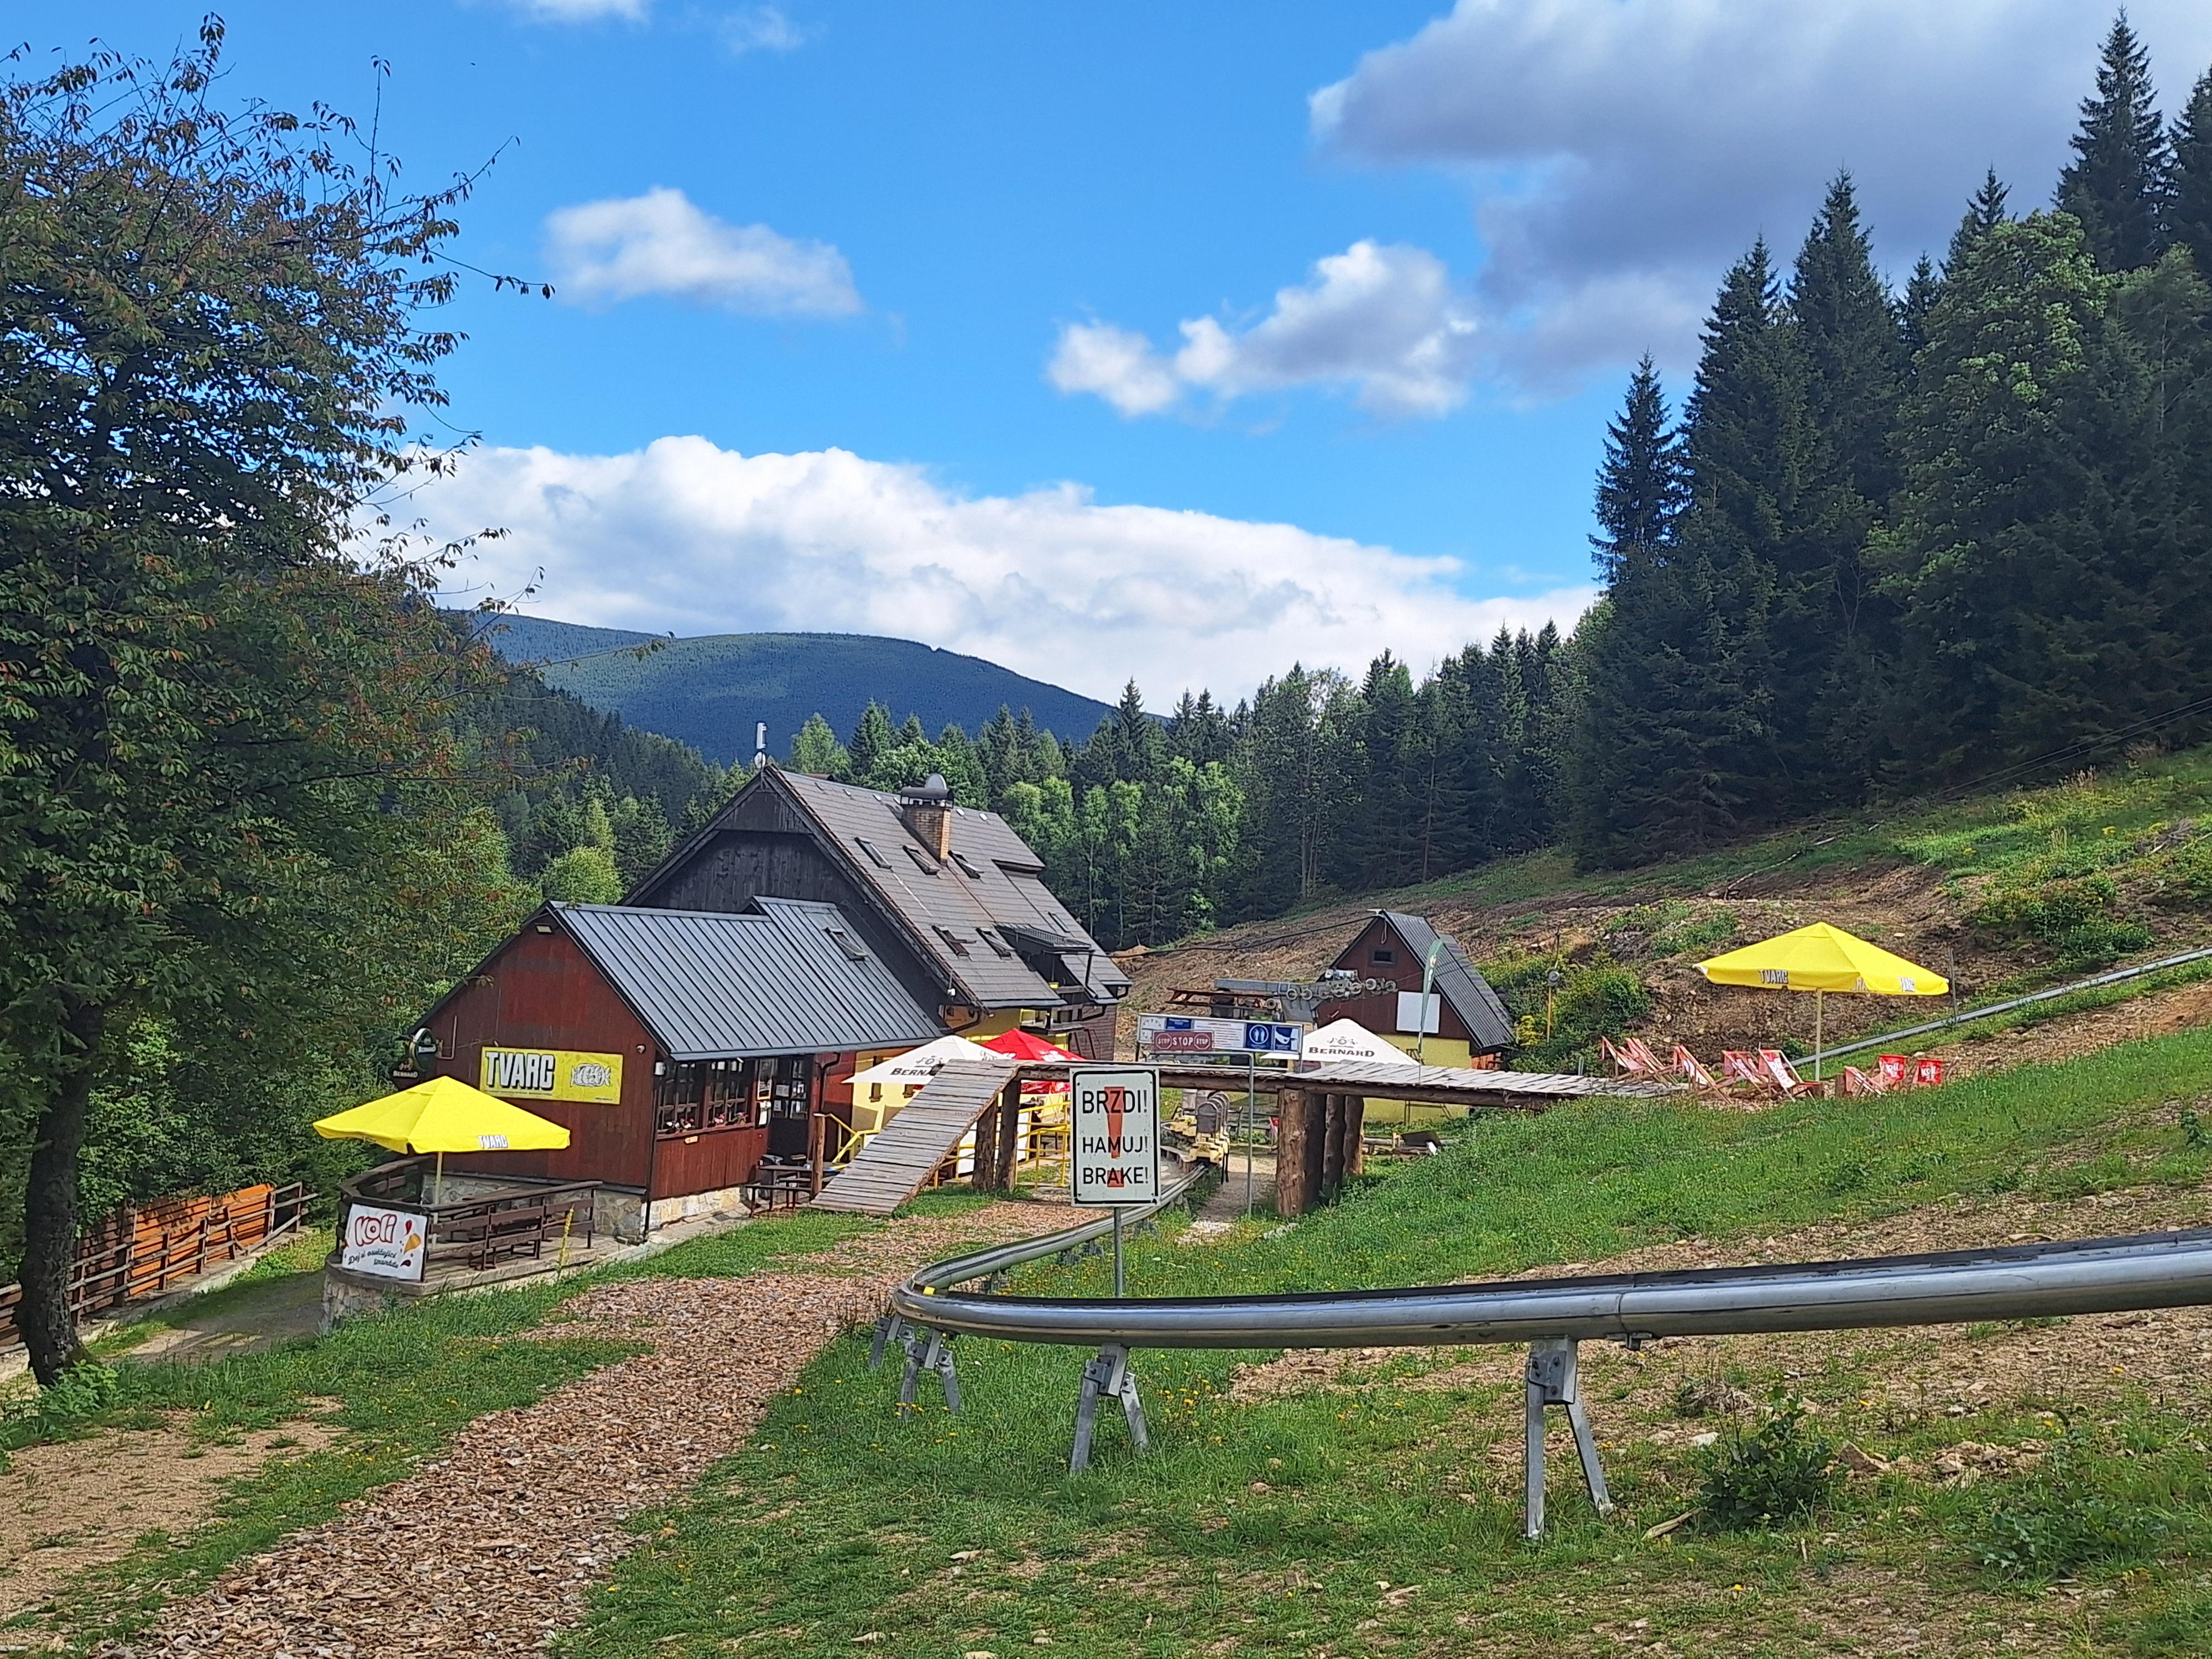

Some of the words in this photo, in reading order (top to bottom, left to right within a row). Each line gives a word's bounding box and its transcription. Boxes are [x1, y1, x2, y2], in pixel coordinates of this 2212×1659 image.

[1172, 1037, 1193, 1046] STOP
[1308, 1047, 1375, 1057] BERNARD
[485, 1051, 556, 1091] TVARG
[1082, 1090, 1147, 1113] BRZDI!
[1083, 1136, 1148, 1154] HAMUJ!
[1083, 1167, 1148, 1184] BRAKE!
